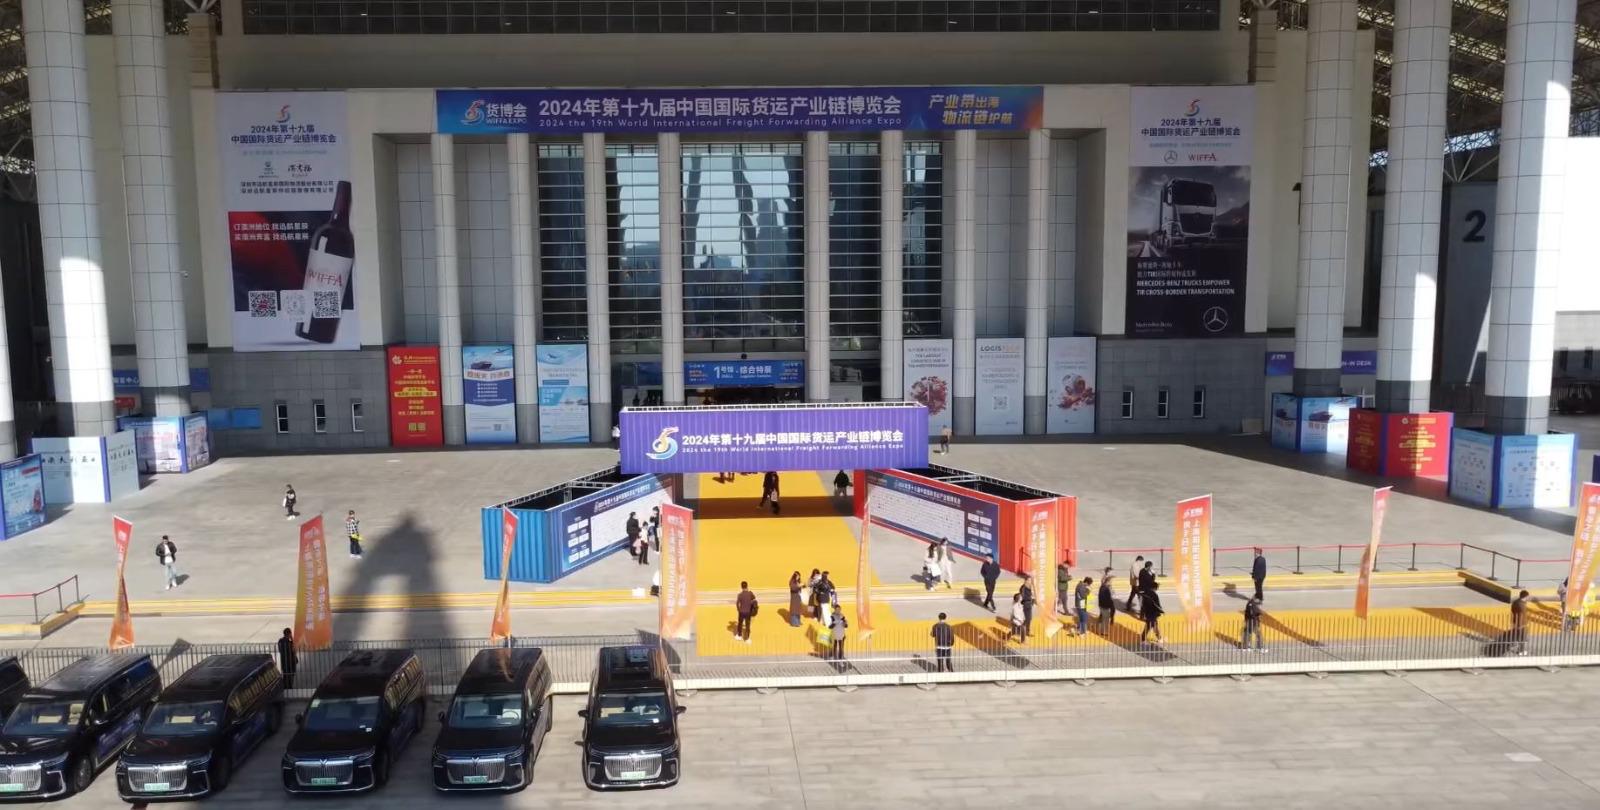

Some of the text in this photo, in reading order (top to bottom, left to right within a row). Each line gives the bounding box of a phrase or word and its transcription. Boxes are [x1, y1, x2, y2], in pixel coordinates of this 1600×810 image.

[486, 103, 527, 117] 货博会
[539, 95, 903, 119] 2024年第十九届中国国际货运产业链博览会
[539, 117, 902, 128] 2024 the 19th World International Freight Forwarding Alliance Expo
[1462, 209, 1486, 243] 2
[1136, 279, 1230, 287] MERCEDES-BENZ TRUCKS EMPOWER
[1188, 288, 1235, 296] TRANSPORTATION
[682, 429, 905, 447] 2024年第十九届中国国际货运产业链博览会
